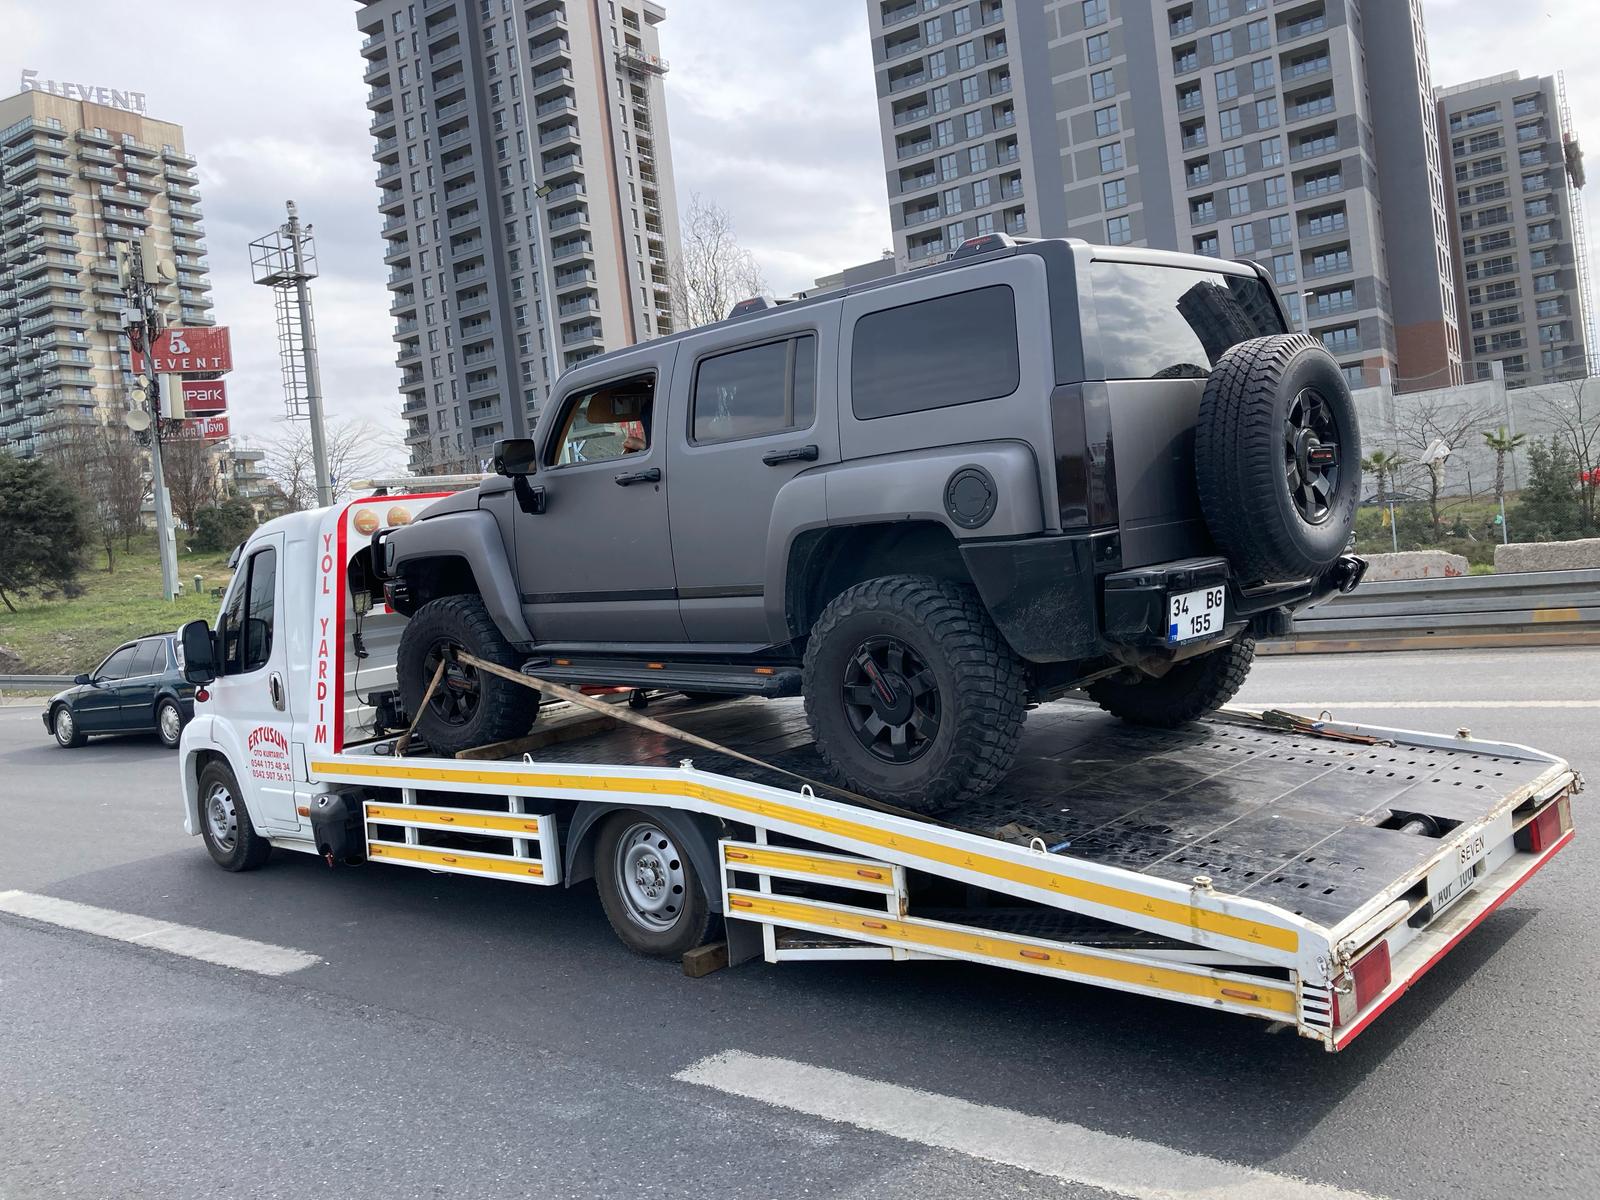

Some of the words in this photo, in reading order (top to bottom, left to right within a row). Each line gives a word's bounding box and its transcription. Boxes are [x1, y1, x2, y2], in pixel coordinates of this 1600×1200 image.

[141, 357, 221, 370] LEVENT
[321, 533, 332, 594] YOL
[1173, 596, 1189, 617] 34
[1206, 589, 1222, 609] BG
[1190, 613, 1211, 634] 155
[314, 617, 329, 744] YARDIM
[248, 726, 289, 755] ERTUSUN
[1460, 834, 1485, 864] SEVEN
